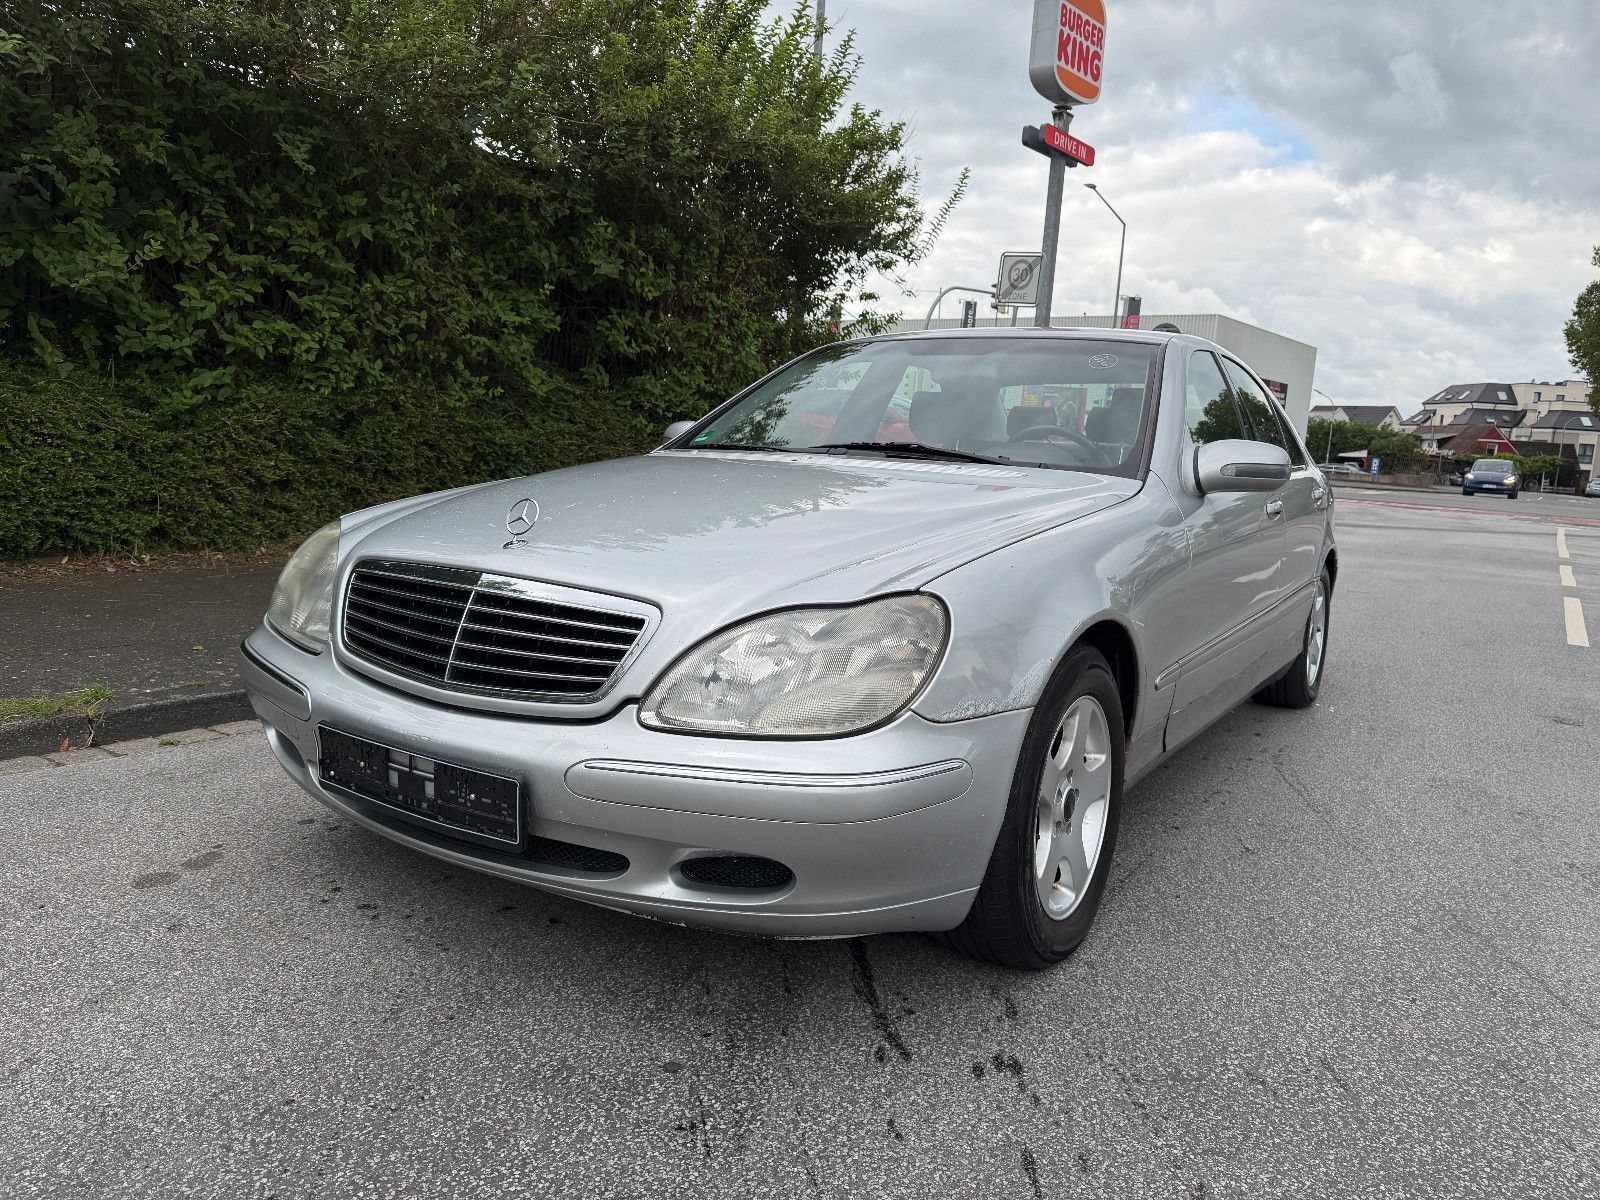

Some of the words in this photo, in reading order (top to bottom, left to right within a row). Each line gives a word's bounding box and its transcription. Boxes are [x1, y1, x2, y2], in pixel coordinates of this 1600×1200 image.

[1060, 3, 1104, 50] BURGER
[1057, 29, 1102, 82] KING
[1054, 131, 1077, 154] DRIVE
[1078, 144, 1087, 160] IN
[1012, 267, 1029, 282] 30
[1008, 292, 1028, 301] ZONE
